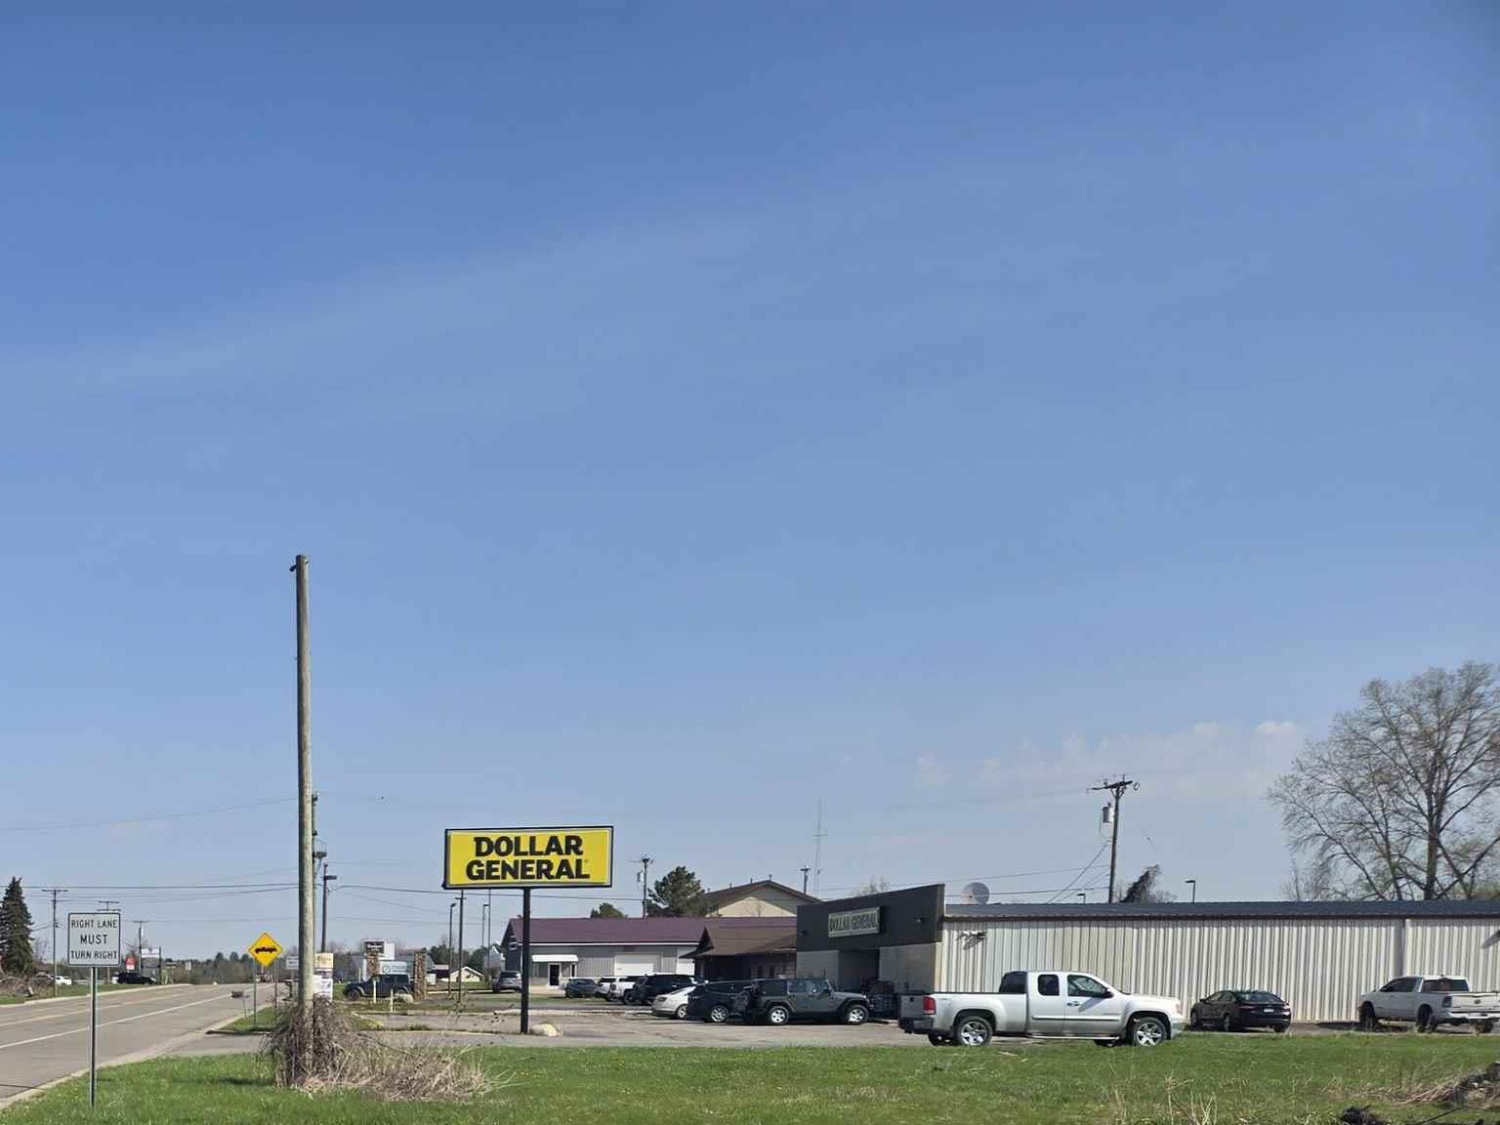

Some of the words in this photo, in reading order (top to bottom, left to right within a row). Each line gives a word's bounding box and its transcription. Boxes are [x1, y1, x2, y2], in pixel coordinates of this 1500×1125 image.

[473, 835, 583, 857] DOLLAR
[466, 859, 590, 881] GENERAL
[71, 919, 94, 929] RIGHT
[97, 919, 118, 929] LANE
[80, 934, 108, 945] MUST
[71, 950, 92, 960] TURN
[94, 950, 117, 960] RIGHT
